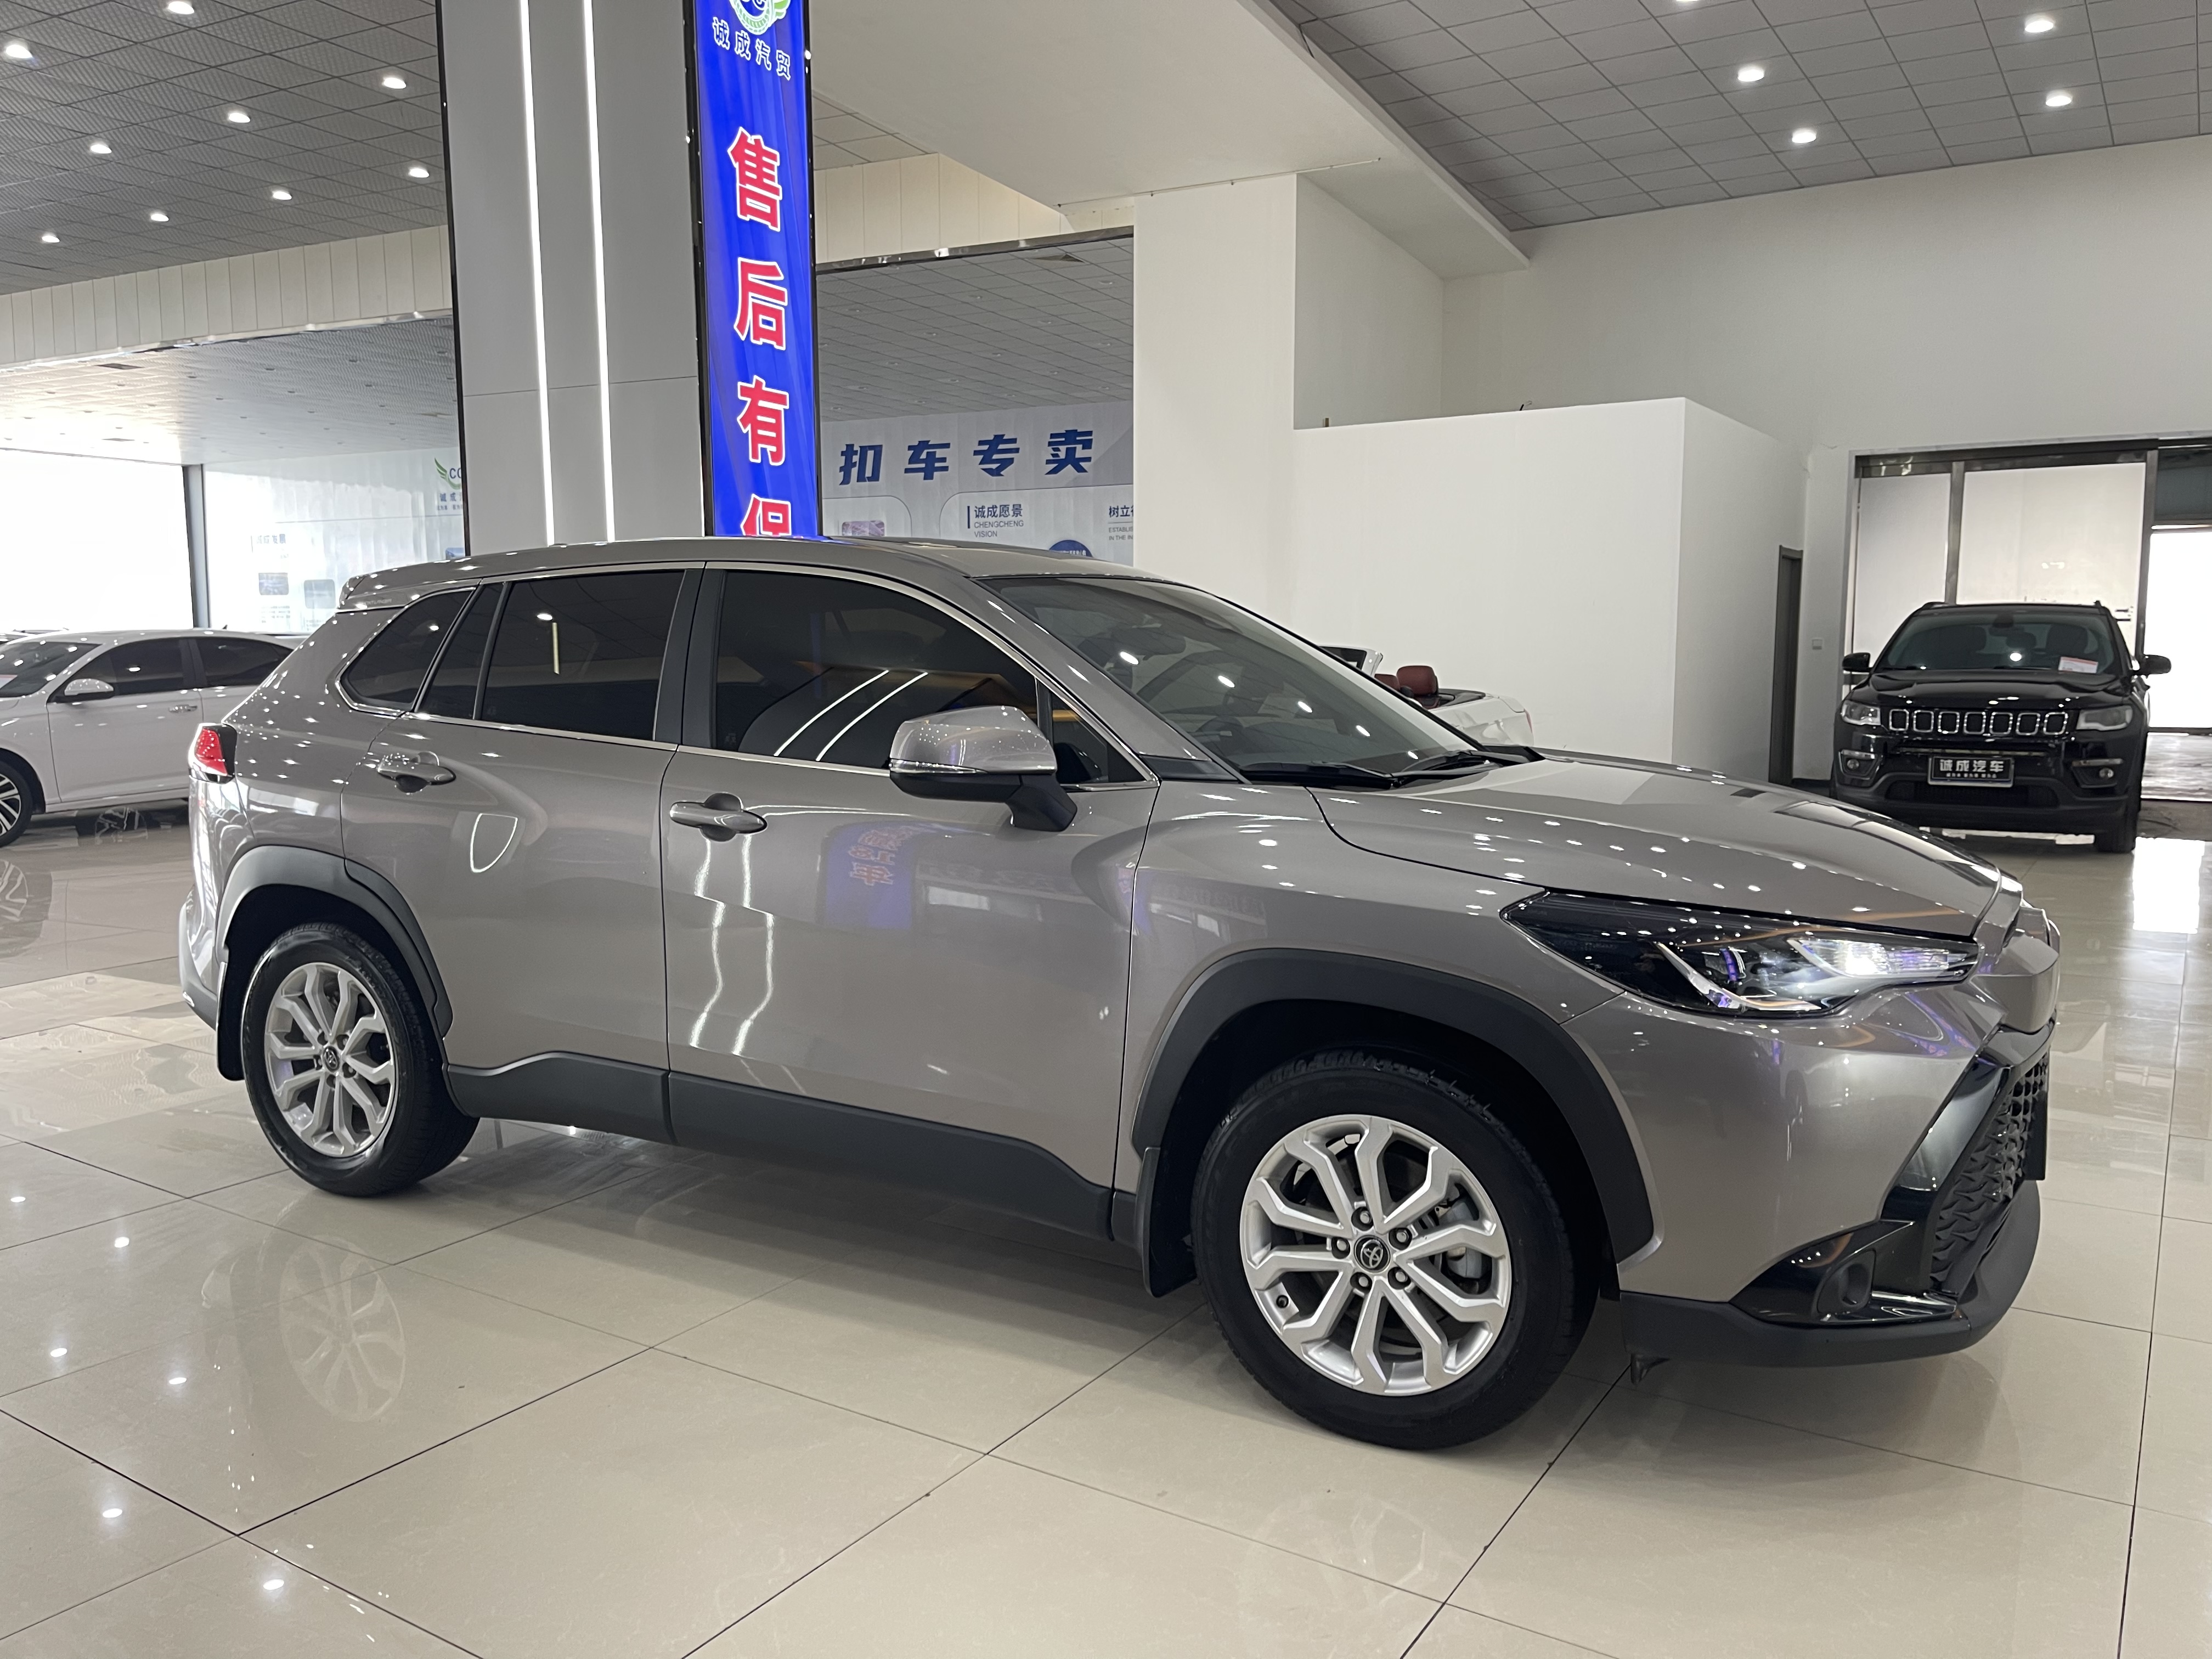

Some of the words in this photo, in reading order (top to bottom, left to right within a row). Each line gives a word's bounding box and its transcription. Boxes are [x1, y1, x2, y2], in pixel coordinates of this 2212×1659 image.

[713, 17, 791, 80] 诚成汽贸
[839, 429, 1093, 485] 扣车专卖
[974, 504, 1023, 518] 诚成愿景
[1109, 505, 1133, 517] 树立
[974, 520, 1024, 528] CHENGCHENG
[1940, 759, 2004, 772] 诚成汽车
